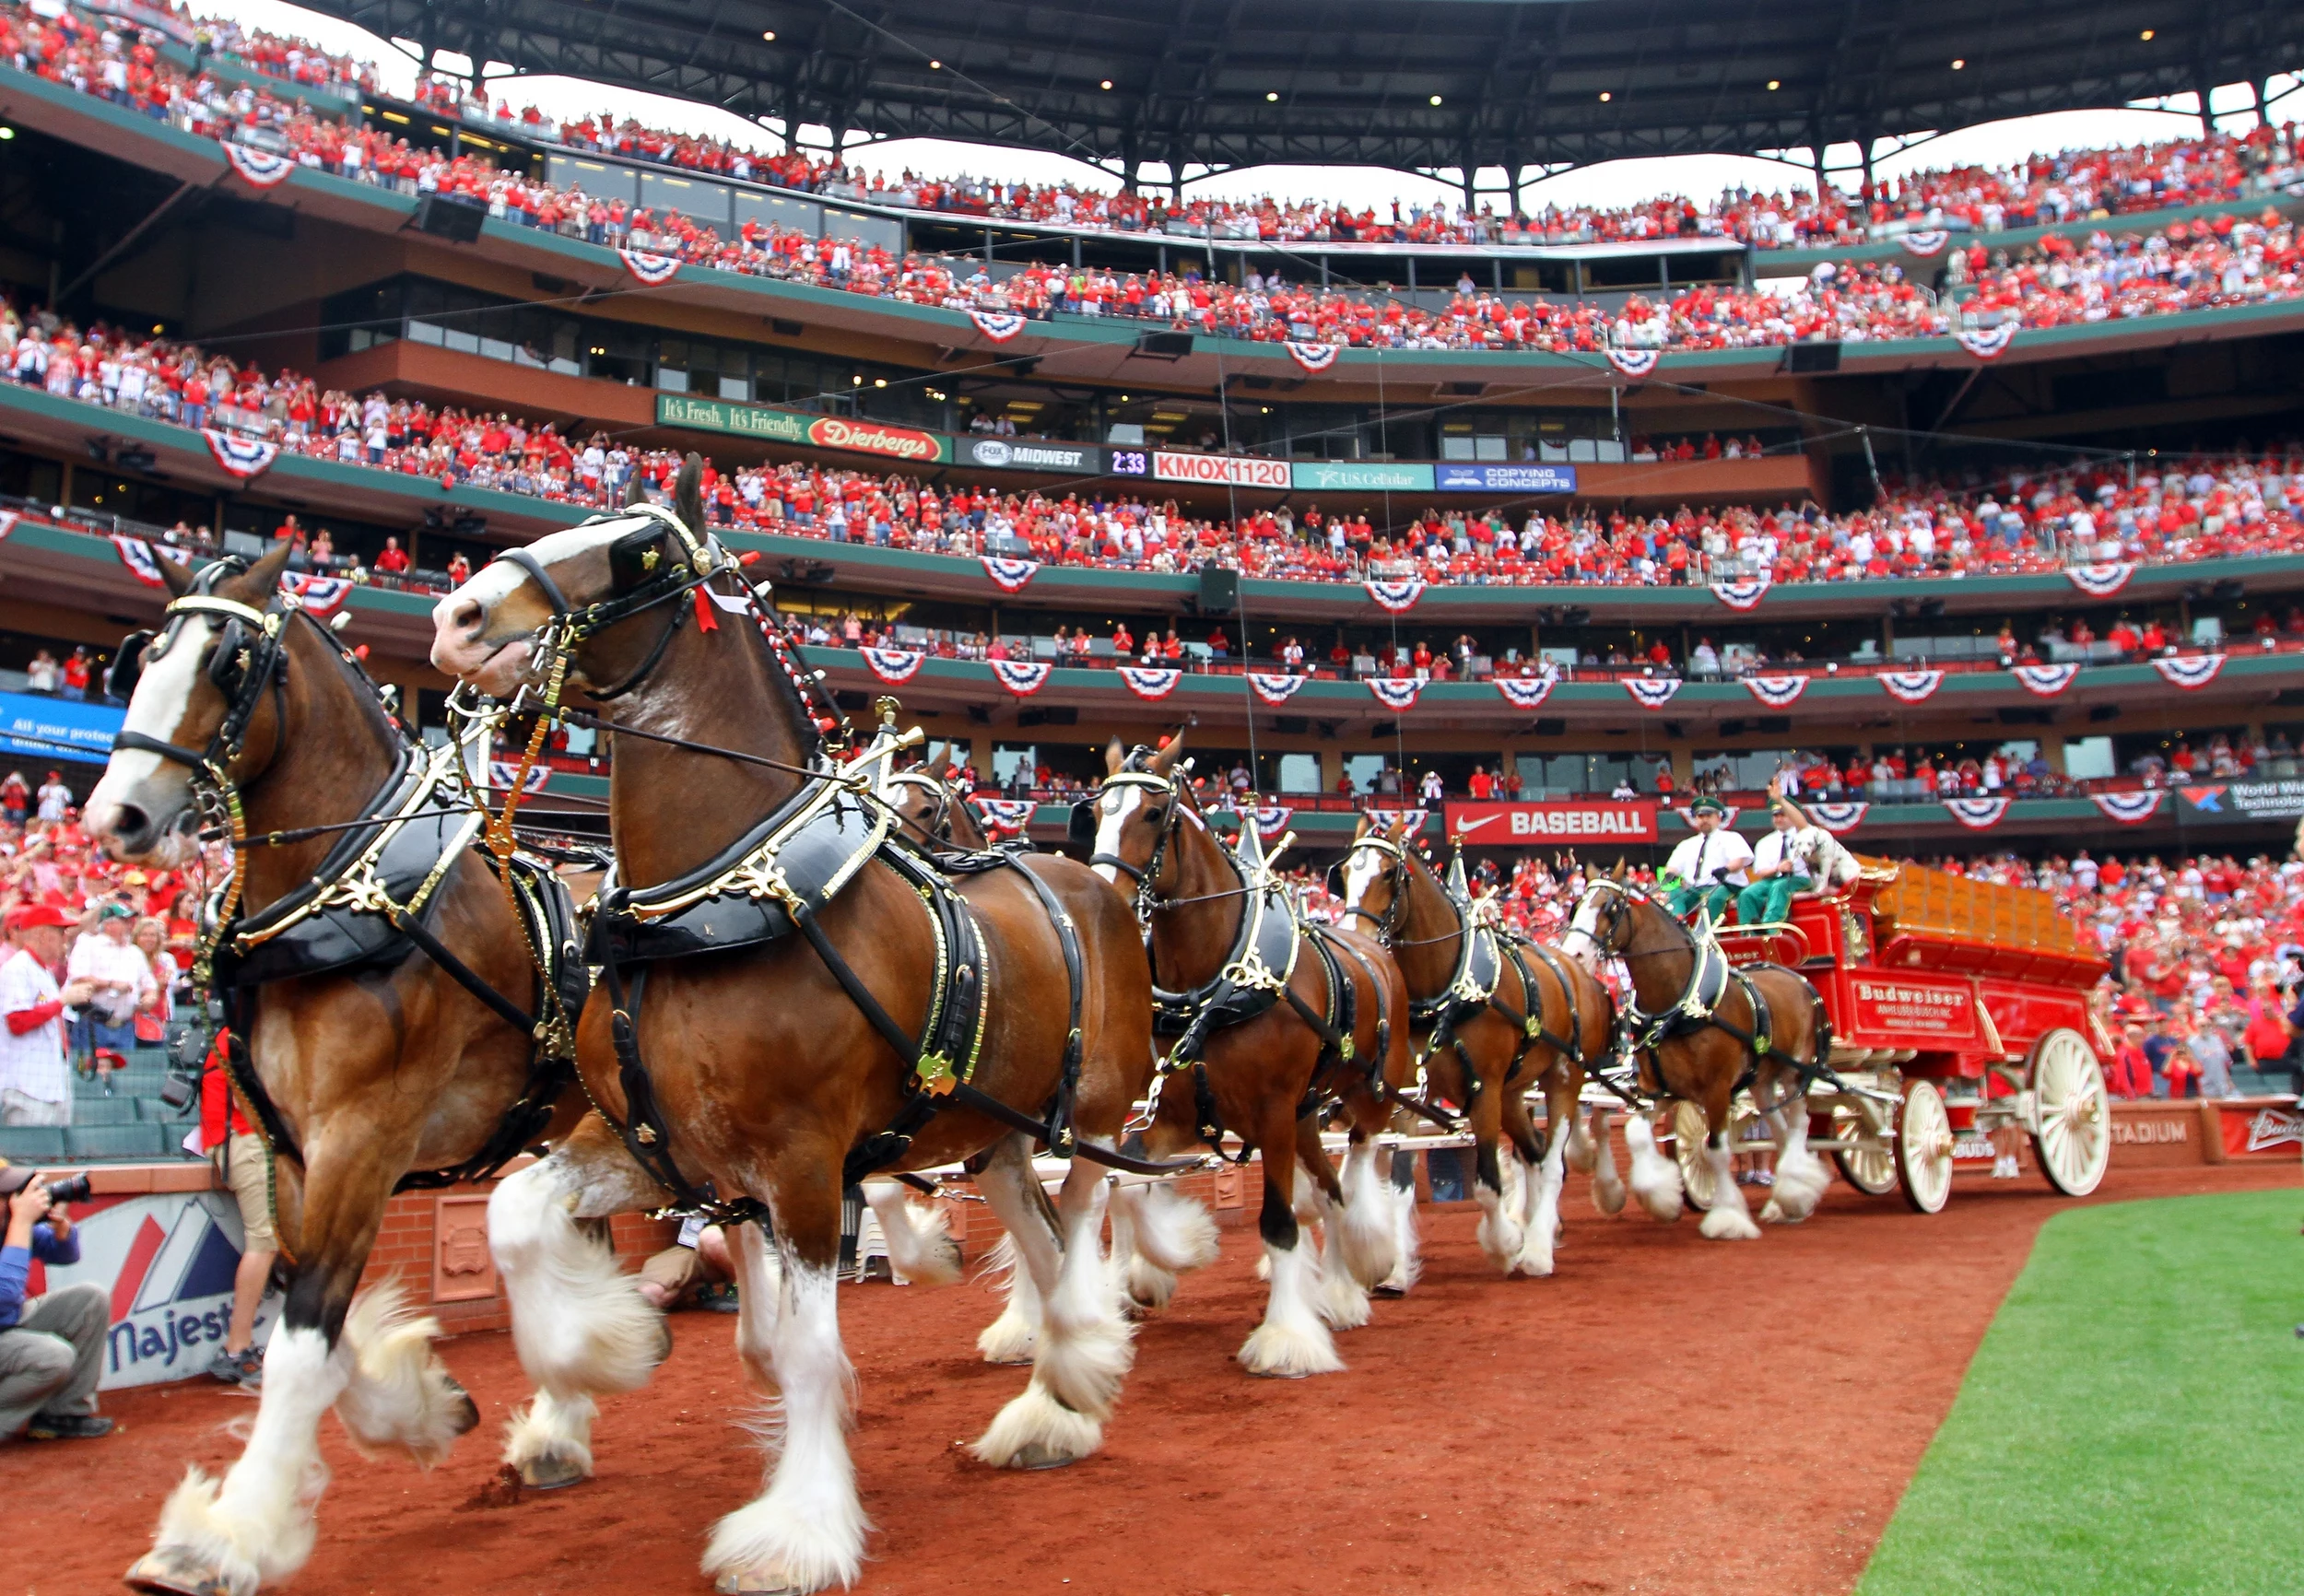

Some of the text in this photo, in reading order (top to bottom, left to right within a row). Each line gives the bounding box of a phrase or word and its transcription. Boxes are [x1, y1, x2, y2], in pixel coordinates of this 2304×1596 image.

[664, 398, 802, 441] It's Fresh. It's Friendly.
[824, 420, 927, 458] Dierbergs
[1013, 446, 1083, 466] MIDWEST
[1112, 452, 1145, 474] 2:33
[1364, 472, 1415, 486] Cellular
[1486, 468, 1556, 477] COPYING
[1486, 477, 1570, 487] CONCEPTS
[36, 723, 67, 737] your
[69, 728, 115, 745] protec
[2232, 782, 2277, 797] World
[2234, 795, 2304, 811] Technolo
[1511, 811, 1648, 835] BASEBALL
[1859, 983, 1963, 1006] Budweiser
[2110, 1120, 2188, 1144] TADIUM
